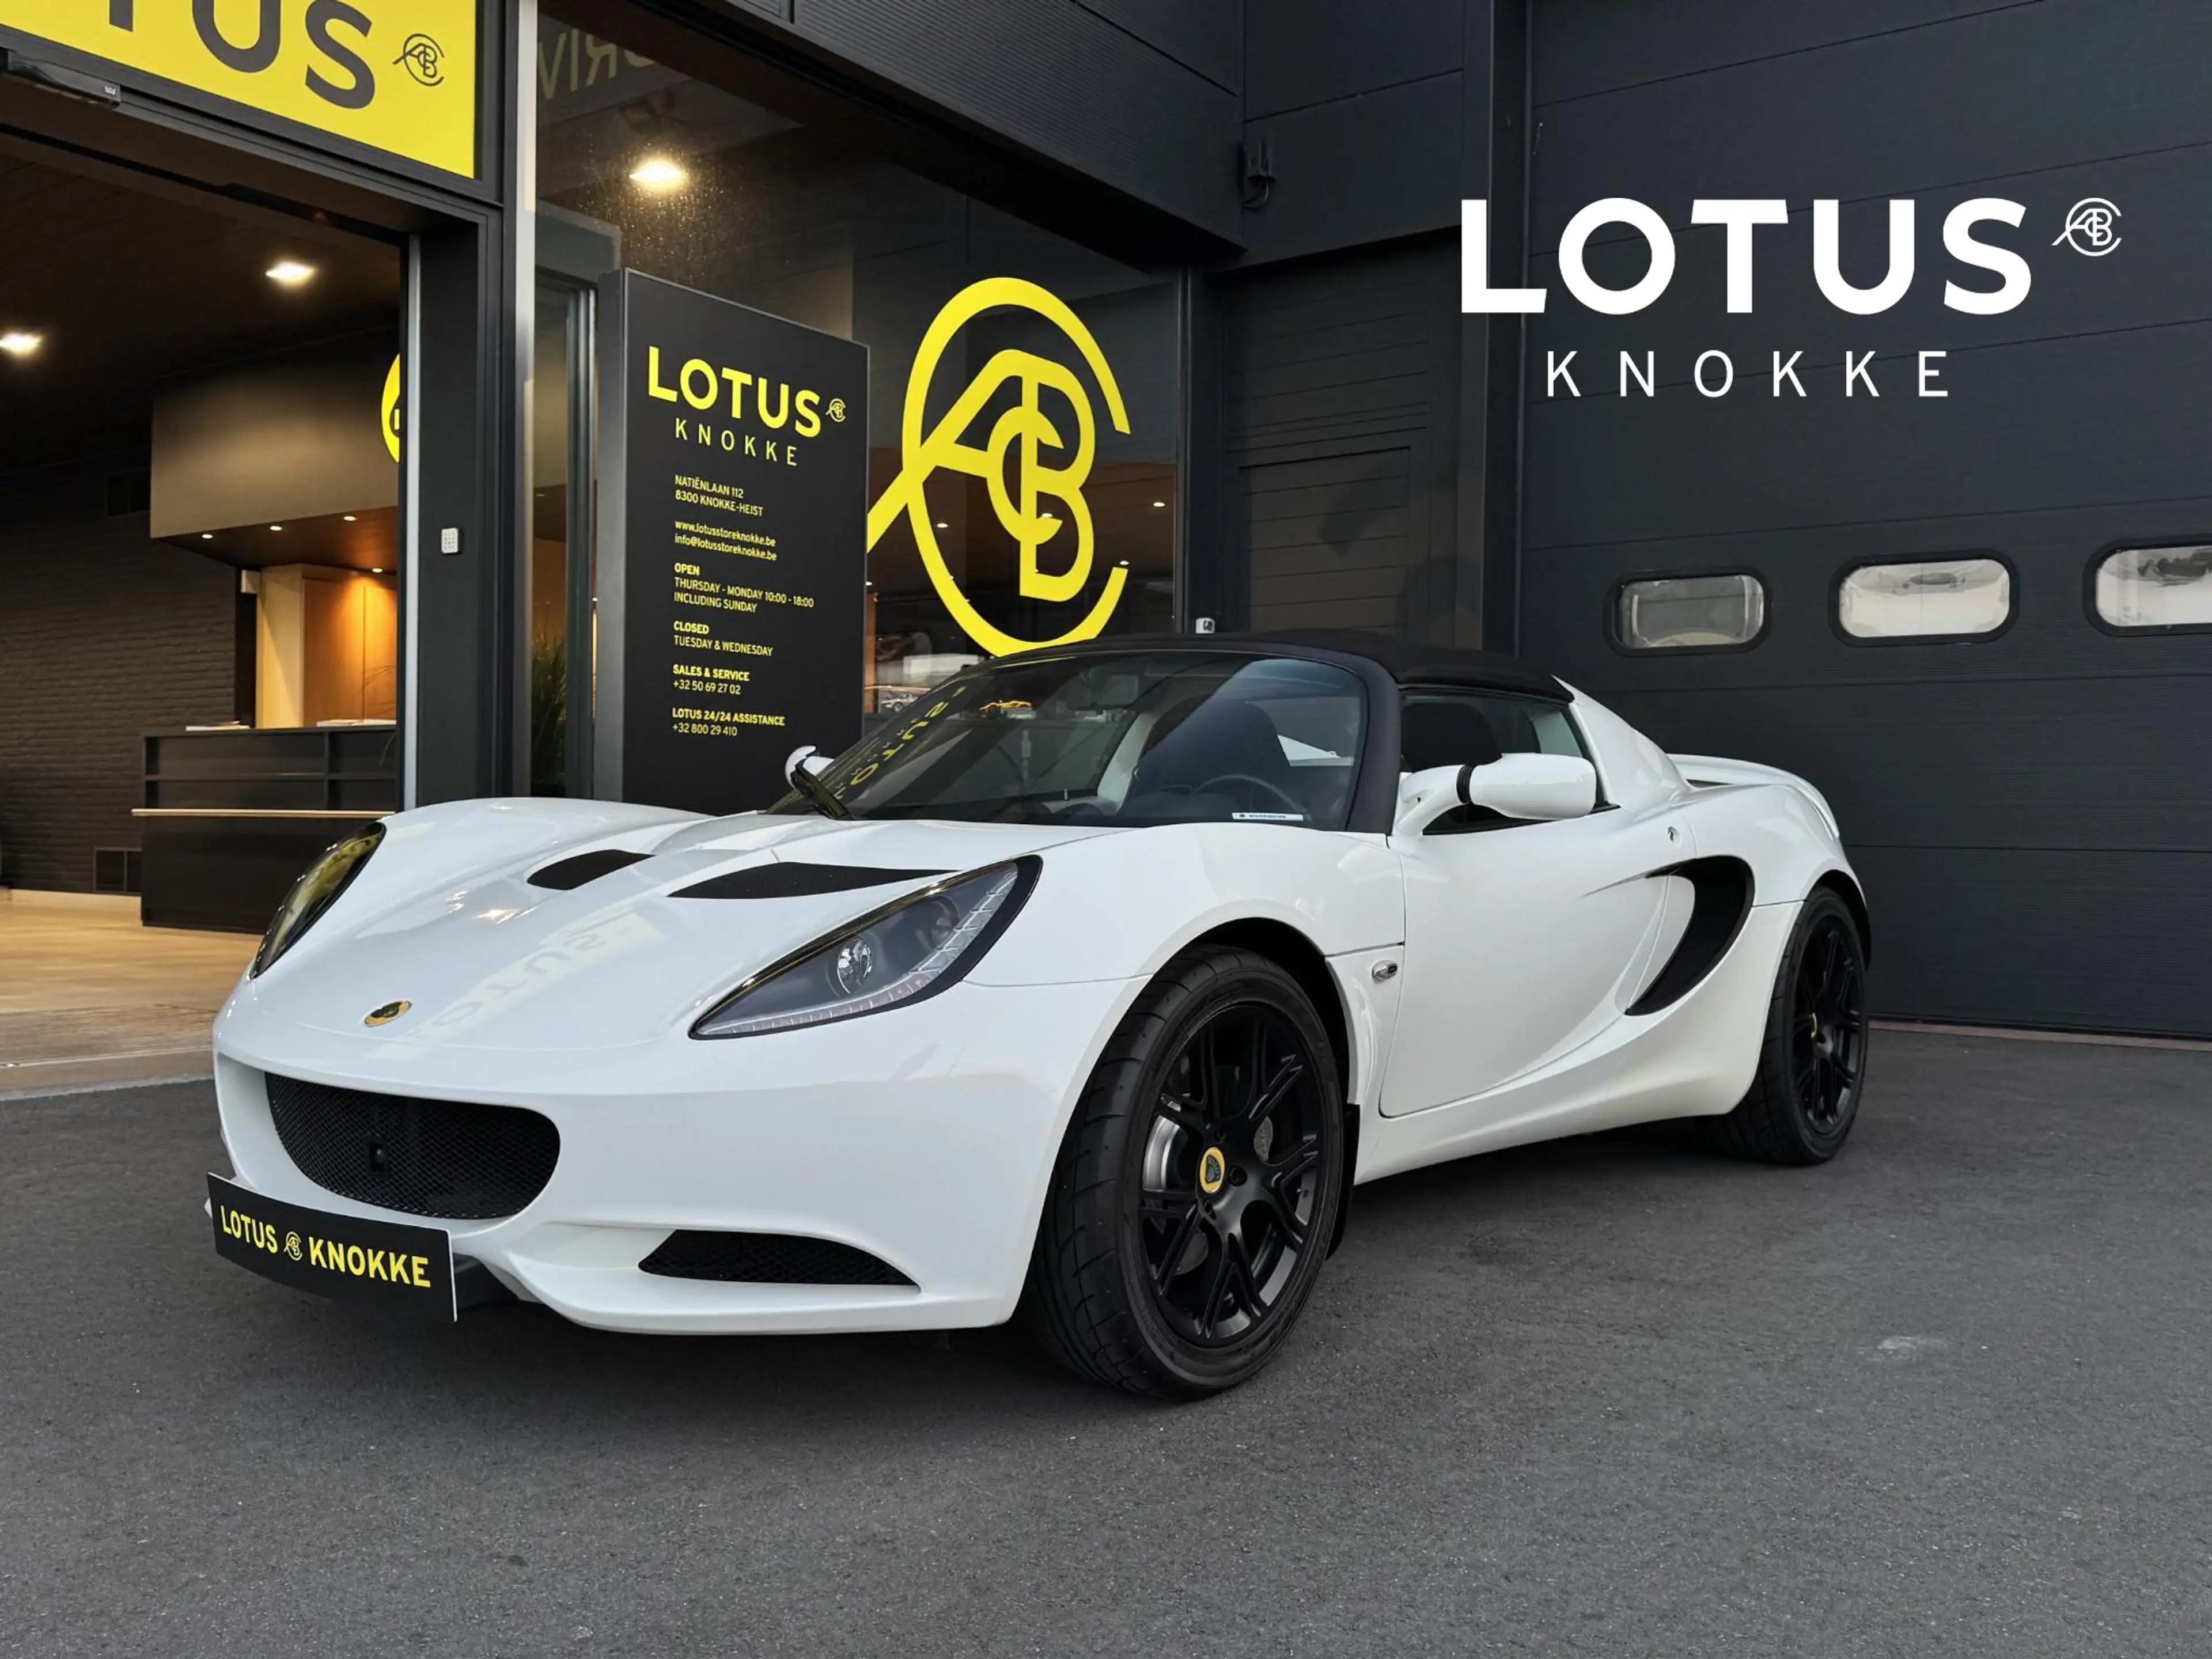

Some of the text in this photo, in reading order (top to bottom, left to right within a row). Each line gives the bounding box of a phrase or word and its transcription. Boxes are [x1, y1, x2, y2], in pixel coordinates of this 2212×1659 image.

[648, 346, 821, 437] LOTUS
[675, 417, 797, 466] KNOKKE
[675, 474, 744, 499] NATIËNLAAN 112
[675, 490, 764, 517] 8300 KNOKKE-HEIST
[675, 520, 776, 547] www.lotusstoreknokke.be
[675, 533, 777, 561] info@lotusstoreknokke.be
[674, 562, 700, 576] OPEN
[674, 577, 720, 593] THURSDAY
[727, 585, 763, 600] MONDAY
[765, 592, 786, 604] 10:00
[793, 596, 814, 608] 18:00
[674, 592, 757, 613] INCLUDING SUNDAY
[673, 620, 709, 634] CLOSED
[674, 635, 773, 656] TUESDAY & WEDNESDAY
[673, 664, 751, 681] SALES & SERVICE
[673, 679, 741, 695] +32 50 69 27 02
[672, 707, 786, 726] LOTUS 24/24 ASSISTANCE
[672, 722, 737, 737] +32 800 29 410
[219, 1205, 278, 1254] LOTUS
[308, 1236, 431, 1288] KNOKKE
